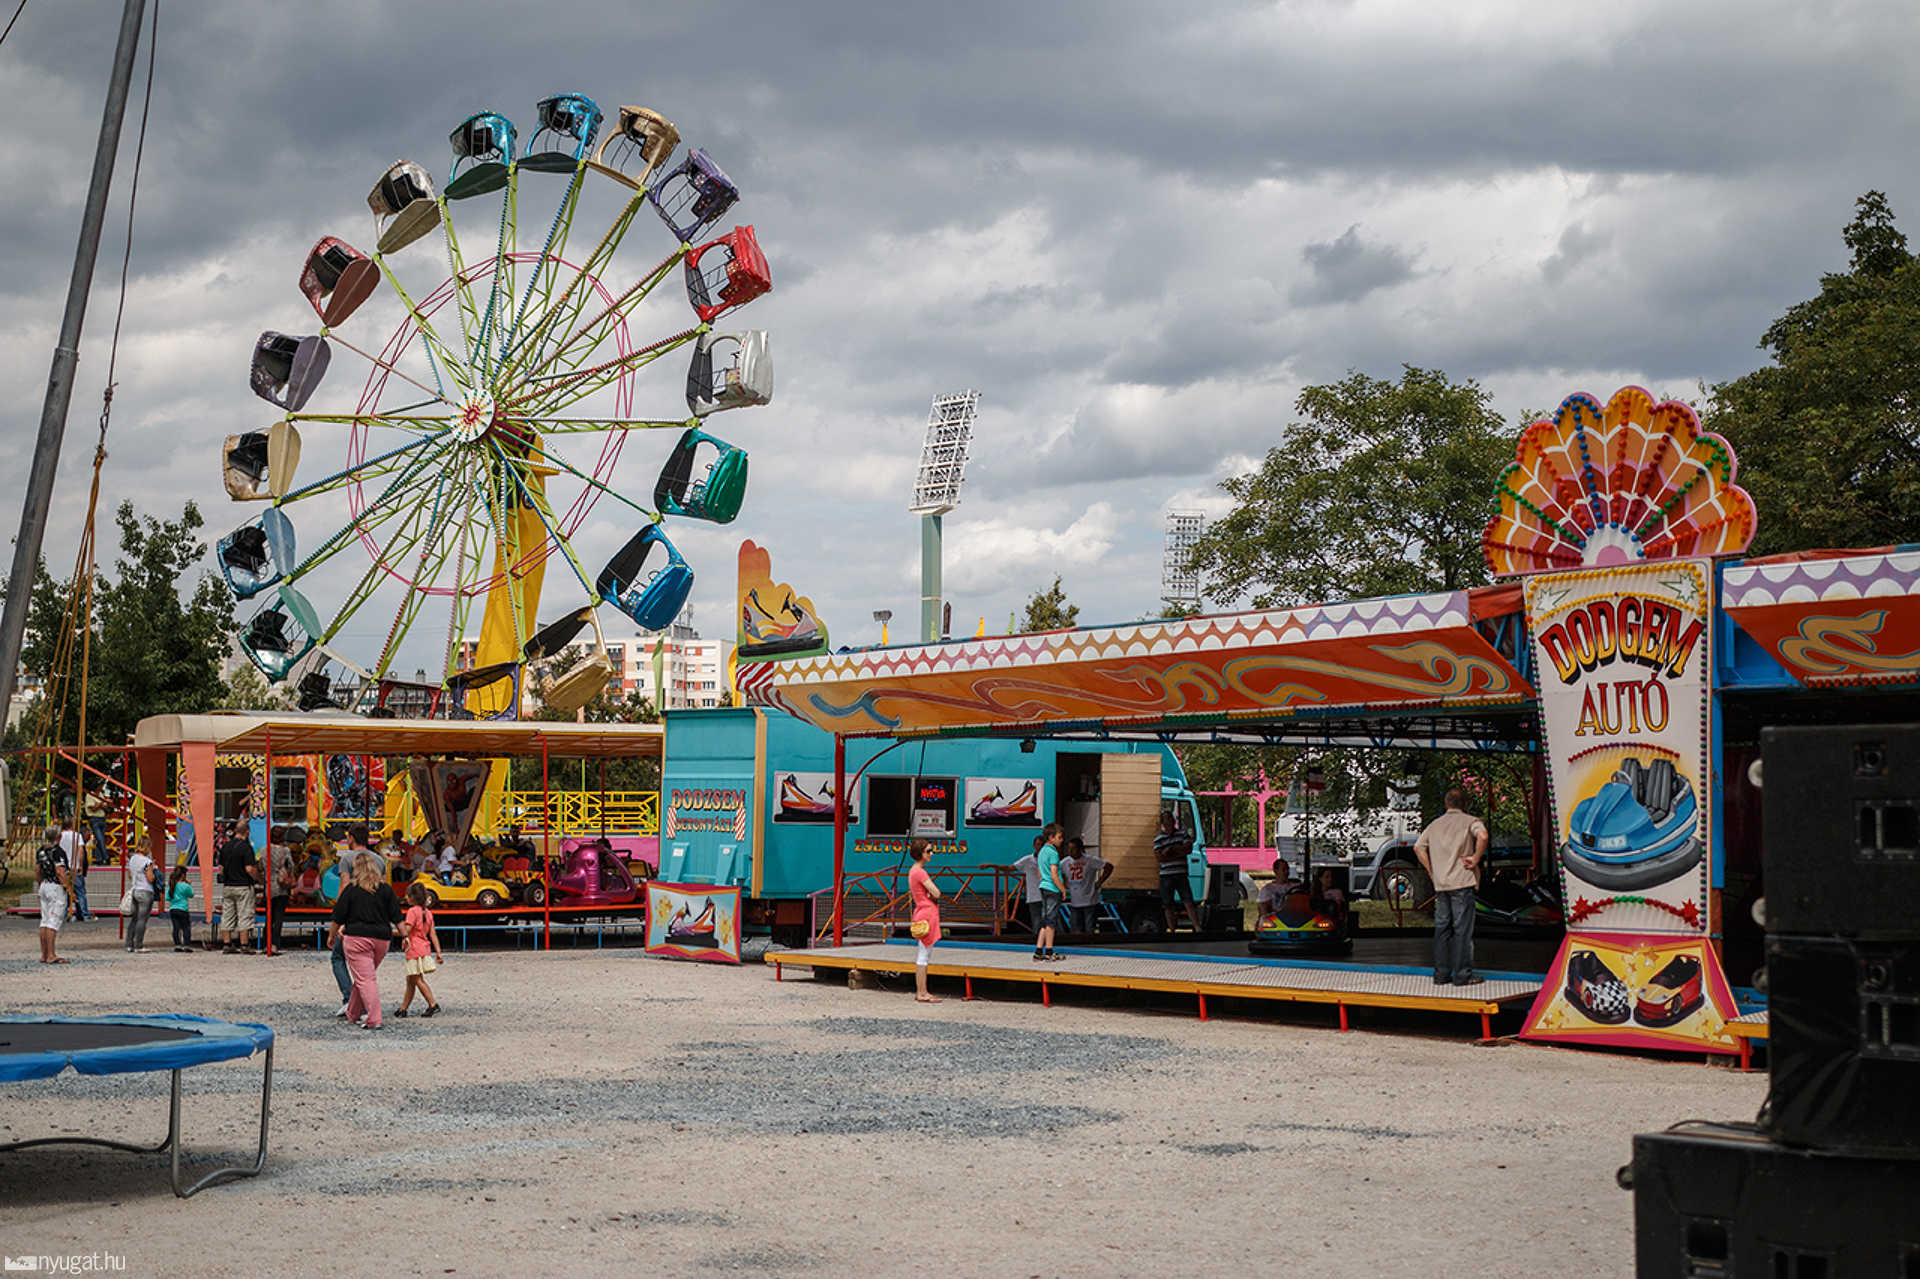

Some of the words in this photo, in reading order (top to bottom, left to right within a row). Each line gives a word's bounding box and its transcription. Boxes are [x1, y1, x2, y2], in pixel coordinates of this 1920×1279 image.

[1538, 597, 1703, 685] DODGEM
[1575, 673, 1669, 736] AUTÓ
[671, 789, 746, 811] DODZSEM
